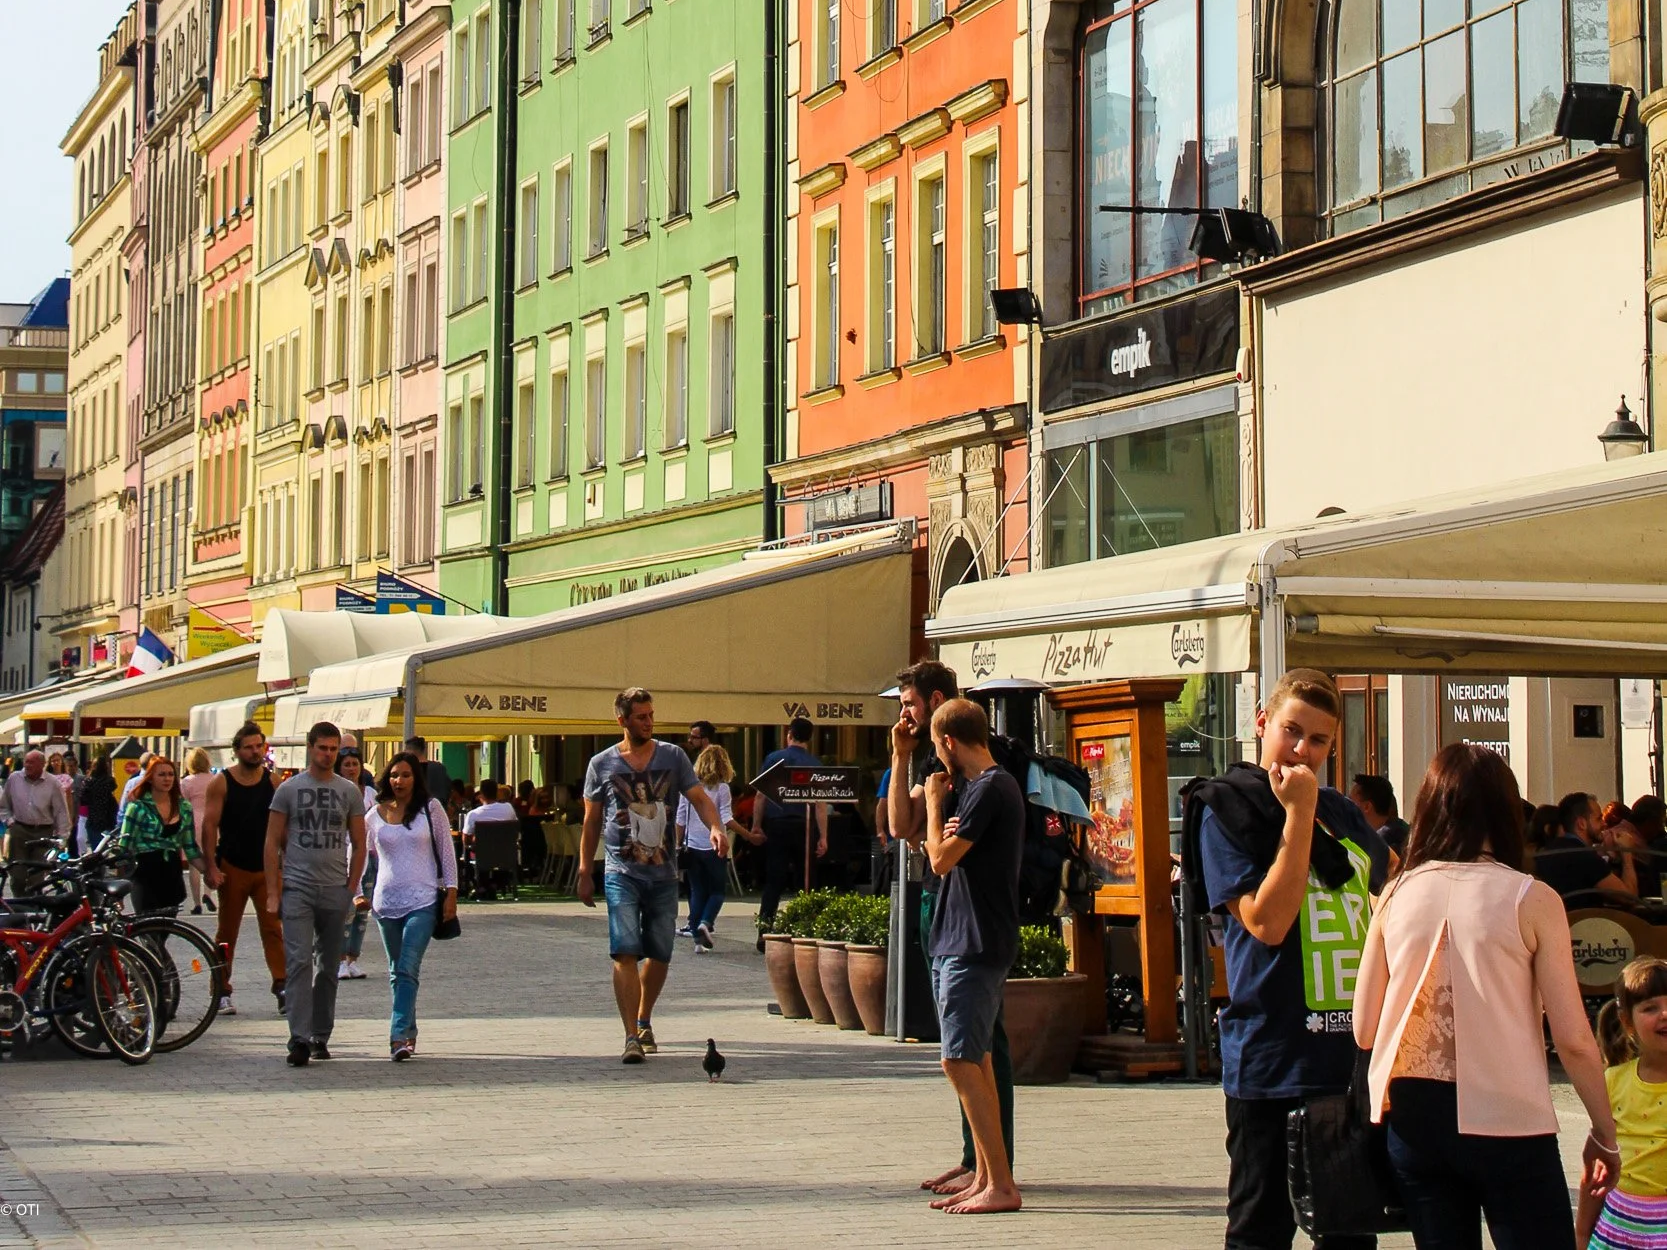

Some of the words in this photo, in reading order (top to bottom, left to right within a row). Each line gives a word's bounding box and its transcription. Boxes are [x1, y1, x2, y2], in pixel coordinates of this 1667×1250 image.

[1111, 328, 1151, 378] empik
[1171, 623, 1205, 662] Carlsberg
[971, 641, 997, 674] Carlsberg
[1041, 633, 1081, 679] Pizza
[1082, 628, 1114, 671] Hut
[463, 694, 493, 711] VA
[499, 695, 548, 712] BENE
[782, 701, 811, 718] VA
[816, 703, 864, 719] BENE
[1454, 705, 1470, 723] NA
[1180, 739, 1201, 749] empik
[297, 787, 348, 809] DEN
[778, 786, 801, 797] Pizza
[801, 789, 810, 797] w
[298, 831, 342, 849] CLTH
